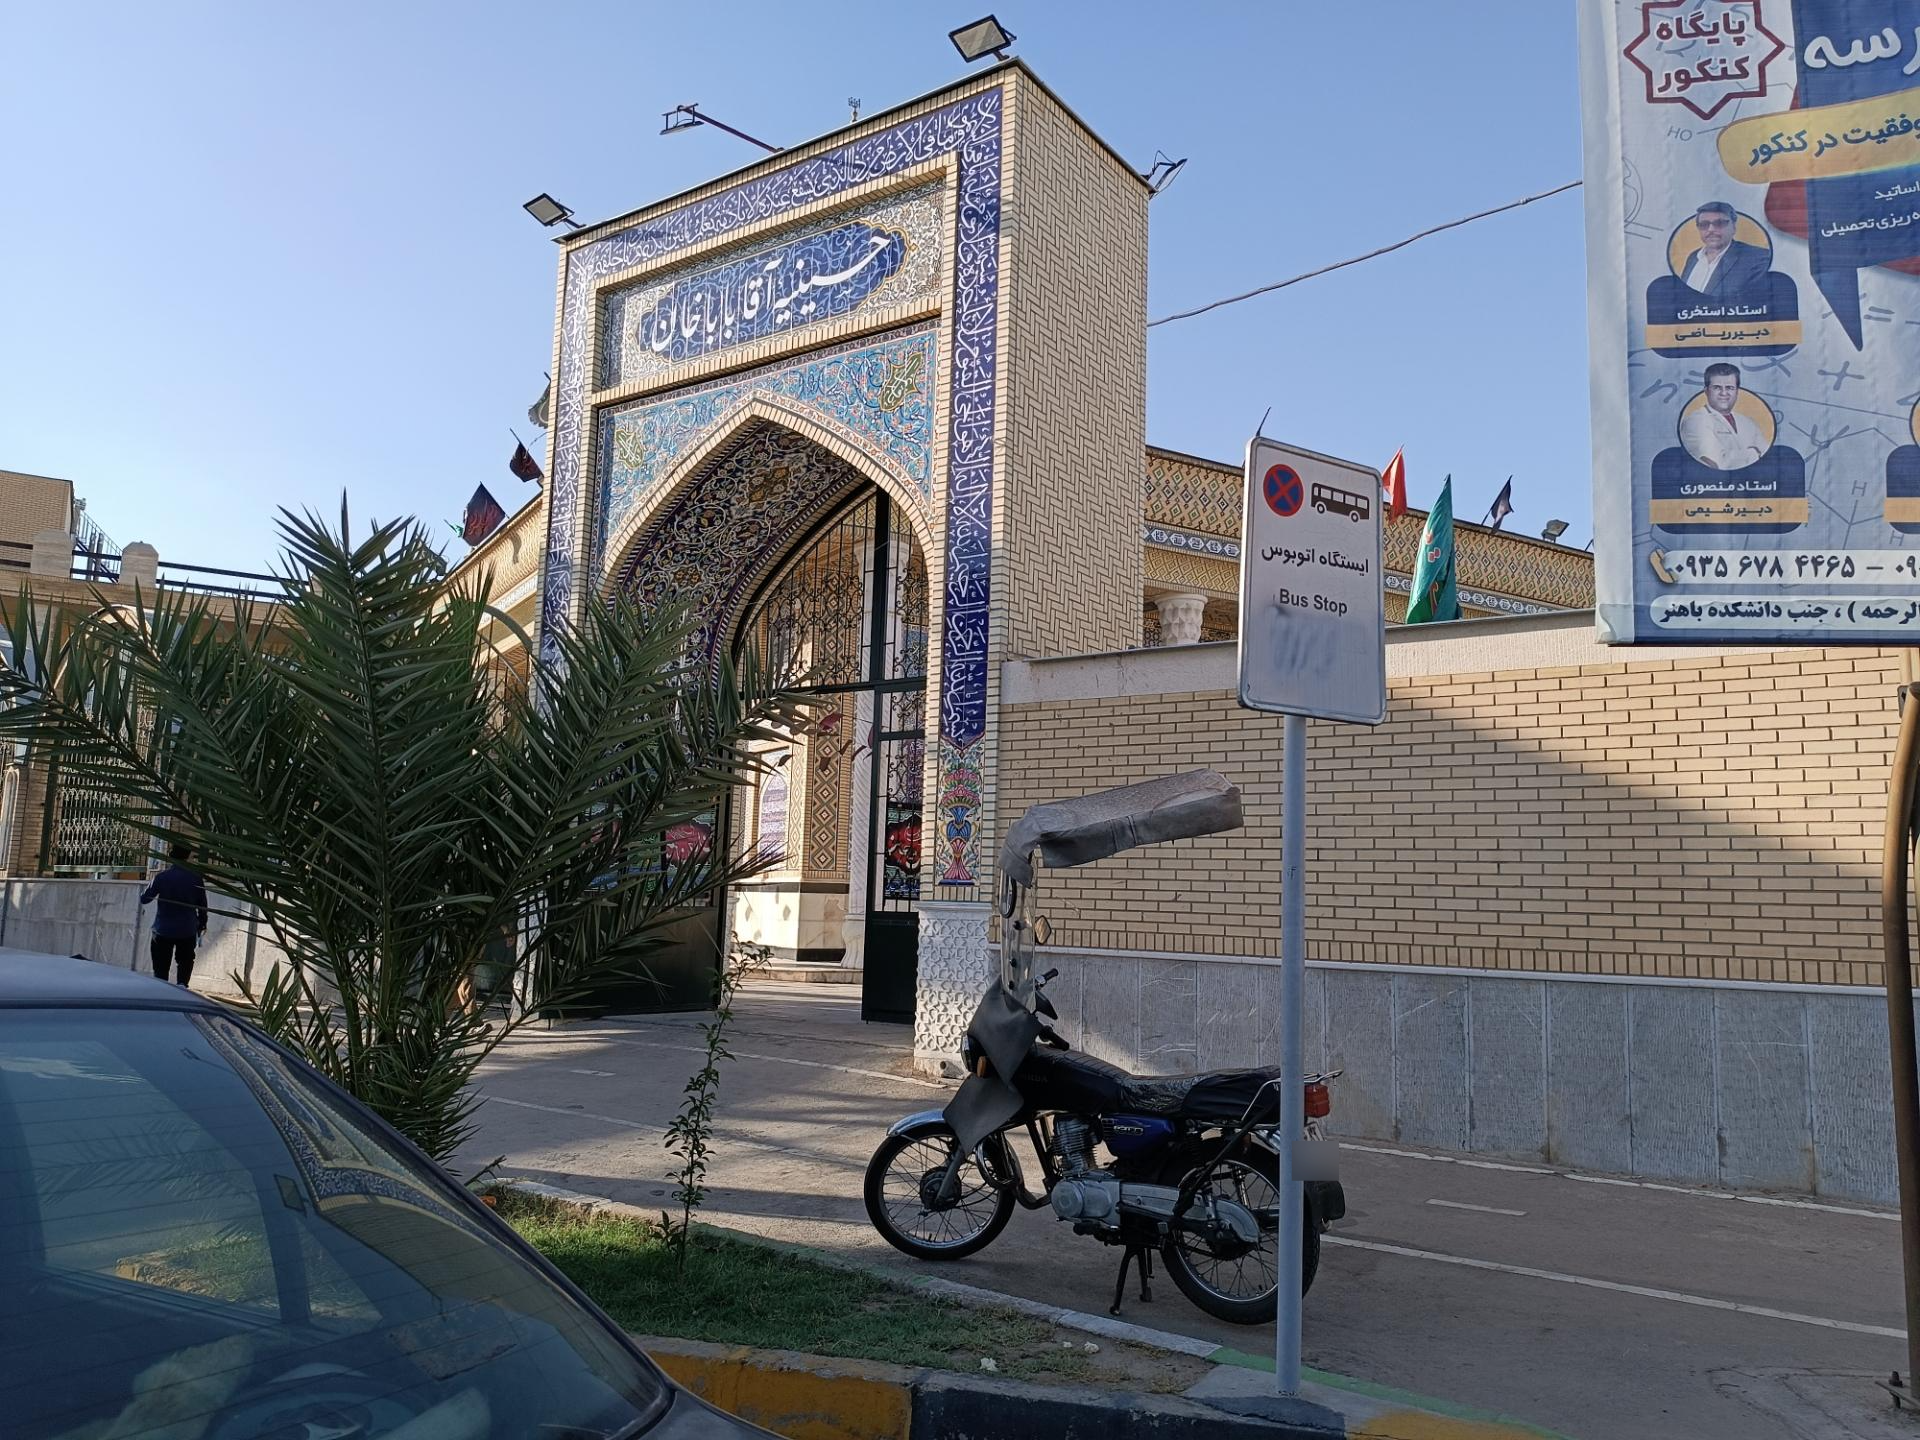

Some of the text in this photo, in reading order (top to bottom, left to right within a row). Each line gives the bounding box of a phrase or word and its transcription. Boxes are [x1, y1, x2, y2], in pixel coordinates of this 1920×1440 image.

[1658, 56, 1749, 93] کنکور
[1749, 130, 1808, 167] کنکور
[1814, 132, 1838, 158] در
[1821, 218, 1876, 237] تحصیلی
[1876, 212, 1912, 230] ریزی
[1677, 304, 1767, 320] استاد استخری
[1674, 328, 1770, 342] دبیر ریاضی
[1680, 480, 1777, 496] استاد منصوری
[1685, 503, 1772, 518] دبیر شیمی
[1261, 546, 1369, 577] ایستگاه اتوبوس
[1675, 556, 1728, 577] ۰۹۳۵
[1739, 556, 1784, 577] ۶۷۸
[1795, 555, 1855, 578] ۴۴۶۵
[1280, 588, 1348, 617] Bus Stop
[1660, 600, 1703, 622] باهنر
[1708, 600, 1783, 618] دانشکده
[1787, 604, 1828, 622] جنب
